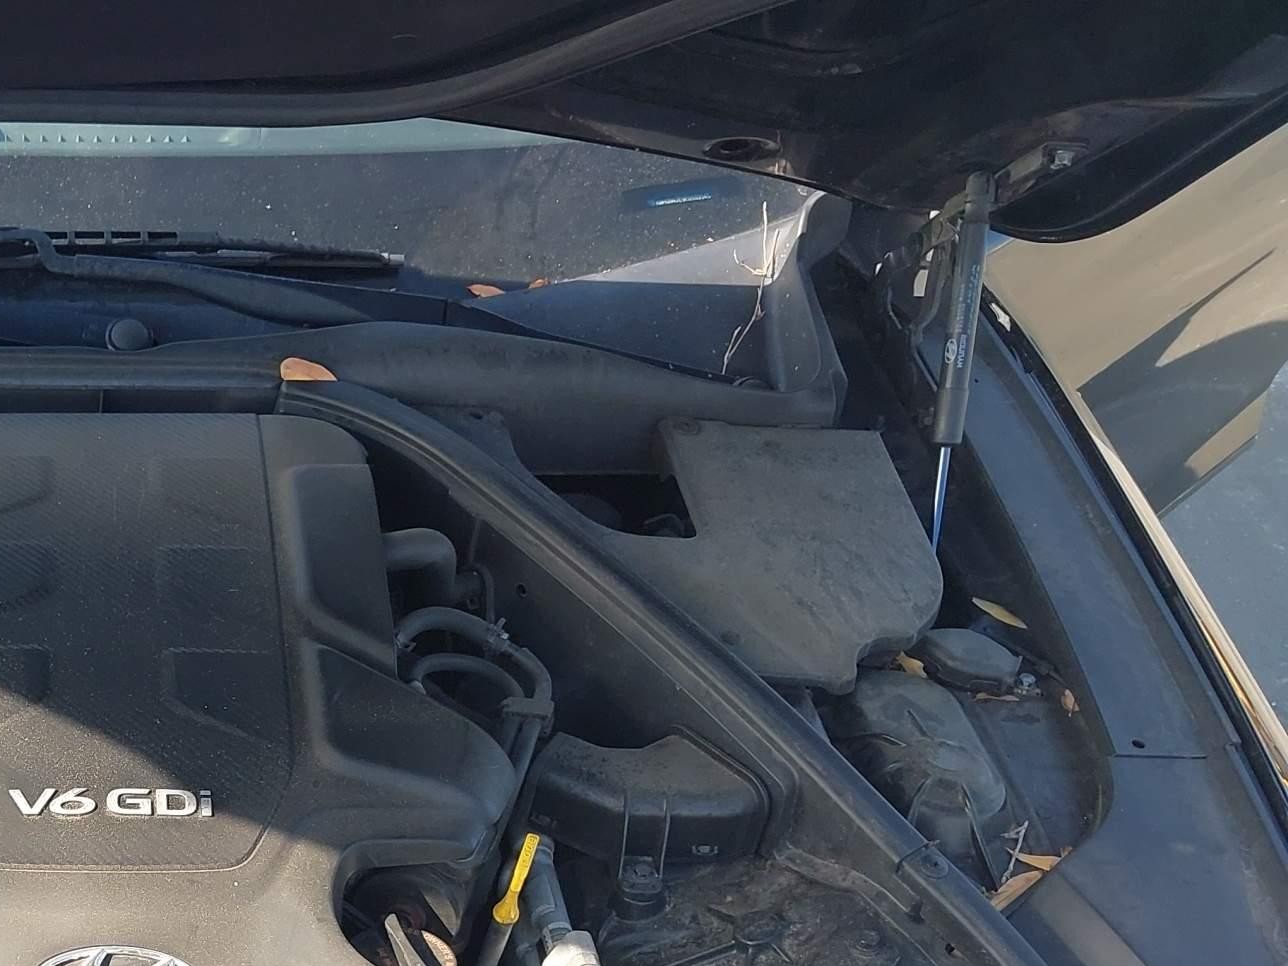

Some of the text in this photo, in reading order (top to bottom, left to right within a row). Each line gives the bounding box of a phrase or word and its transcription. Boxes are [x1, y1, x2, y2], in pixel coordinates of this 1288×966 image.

[956, 334, 968, 368] HYUNDAI
[8, 787, 215, 817] V6 GDi
